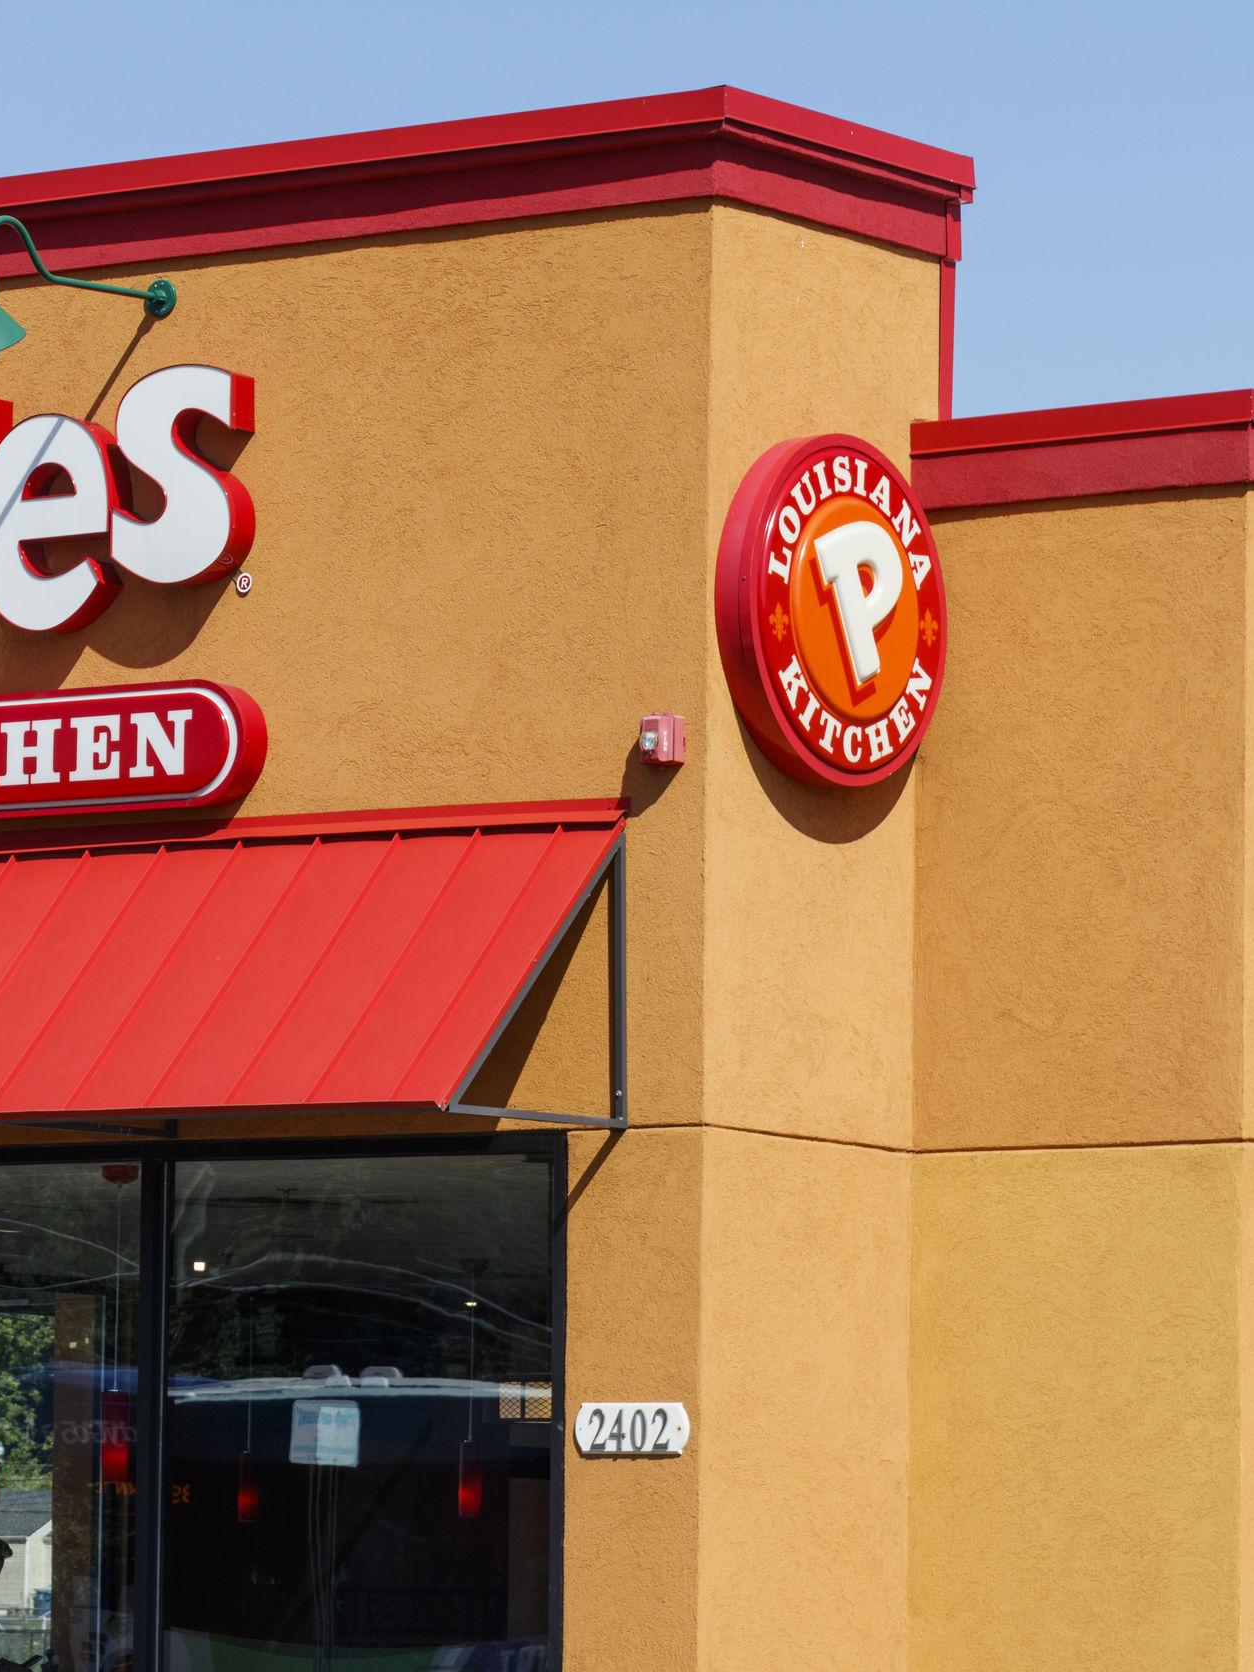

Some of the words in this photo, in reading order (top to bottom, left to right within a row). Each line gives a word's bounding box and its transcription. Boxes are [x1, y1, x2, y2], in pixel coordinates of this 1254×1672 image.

[767, 455, 933, 591] LOUISIANA
[813, 520, 904, 687] P
[778, 654, 933, 764] KITCHEN
[588, 1408, 670, 1452] 2402
